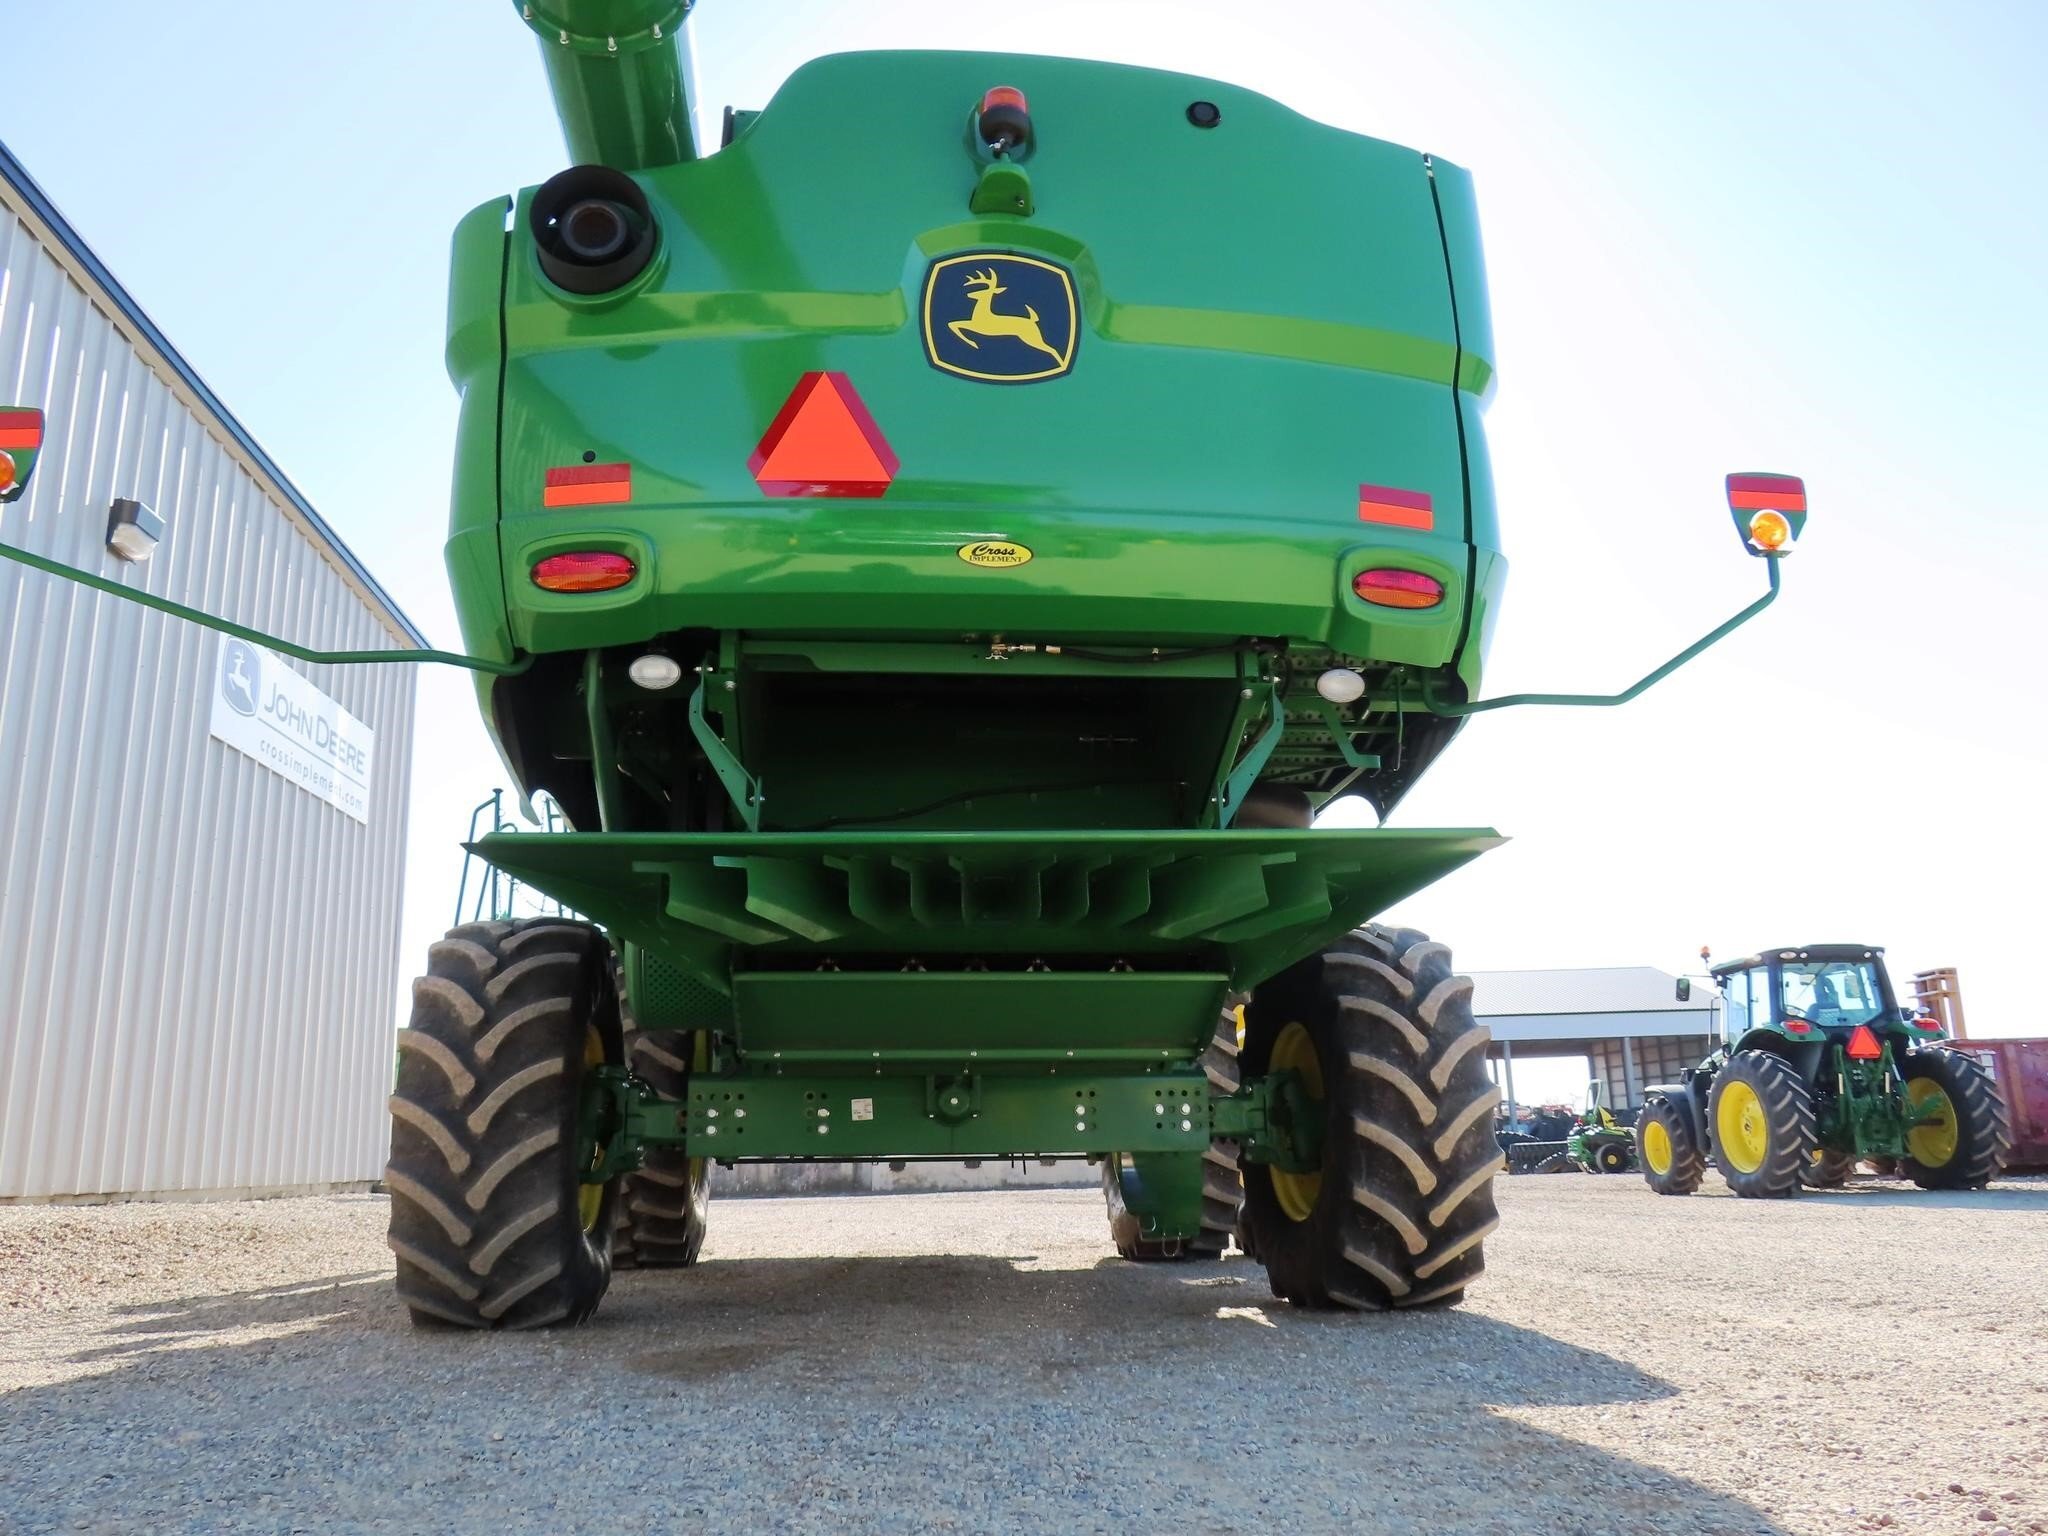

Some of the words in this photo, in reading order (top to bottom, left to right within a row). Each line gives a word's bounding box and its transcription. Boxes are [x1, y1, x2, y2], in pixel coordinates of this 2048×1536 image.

[969, 555, 1023, 563] IMPLEMENT
[972, 543, 1016, 556] Cross
[264, 682, 313, 740] JOHN
[315, 715, 366, 776] DEERE
[260, 739, 363, 811] crossimplemet.com
